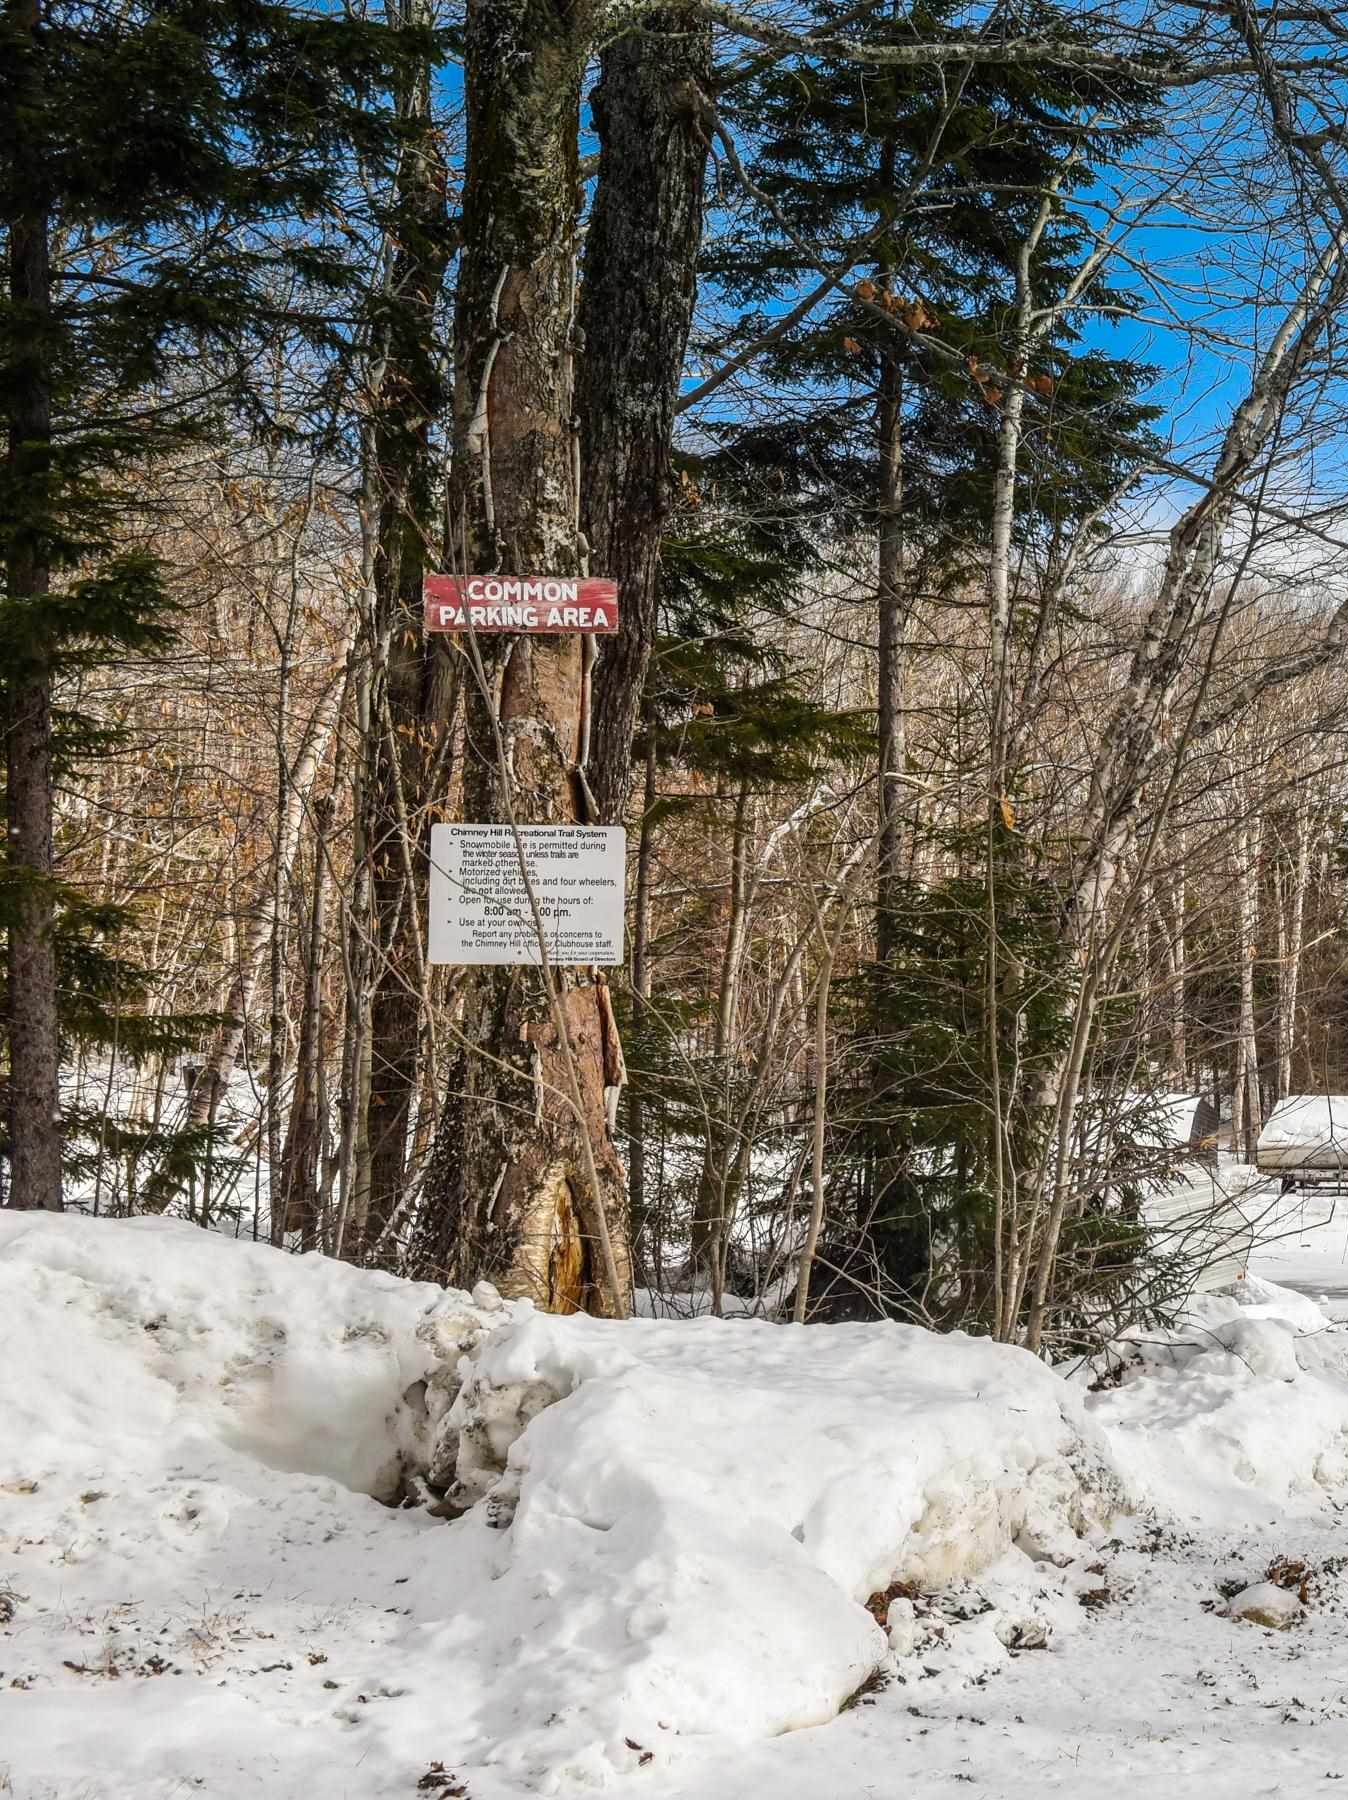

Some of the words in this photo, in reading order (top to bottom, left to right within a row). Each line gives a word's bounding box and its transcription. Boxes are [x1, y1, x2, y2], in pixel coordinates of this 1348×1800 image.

[468, 581, 578, 601] COMMON
[439, 606, 539, 627] PARKING
[547, 607, 609, 627] AREA
[450, 828, 488, 838] Chimney
[490, 828, 502, 836] Hill
[558, 830, 574, 838] Trail
[576, 830, 607, 839] System
[460, 840, 510, 848] Snowmobile
[530, 841, 536, 849] is
[539, 841, 578, 851] permitted
[580, 842, 606, 852] during
[476, 850, 498, 858] winter
[460, 868, 500, 876] Motorized
[502, 868, 538, 878] vehices,
[463, 877, 500, 886] including
[502, 878, 516, 886] dirt
[518, 878, 540, 886] bes
[542, 878, 558, 886] and
[560, 878, 576, 886] four
[578, 878, 617, 887] wheelers,
[478, 886, 492, 894] not
[458, 895, 482, 905] Open
[514, 896, 540, 906] durig
[542, 896, 556, 904] the
[558, 896, 580, 904] hours
[582, 896, 594, 904] of:
[484, 906, 504, 916] 8:00
[459, 918, 475, 926] Use
[488, 920, 506, 928] your
[472, 930, 497, 938] Report
[514, 931, 548, 939] probles
[475, 940, 507, 949] Chimney
[510, 940, 520, 948] Hill
